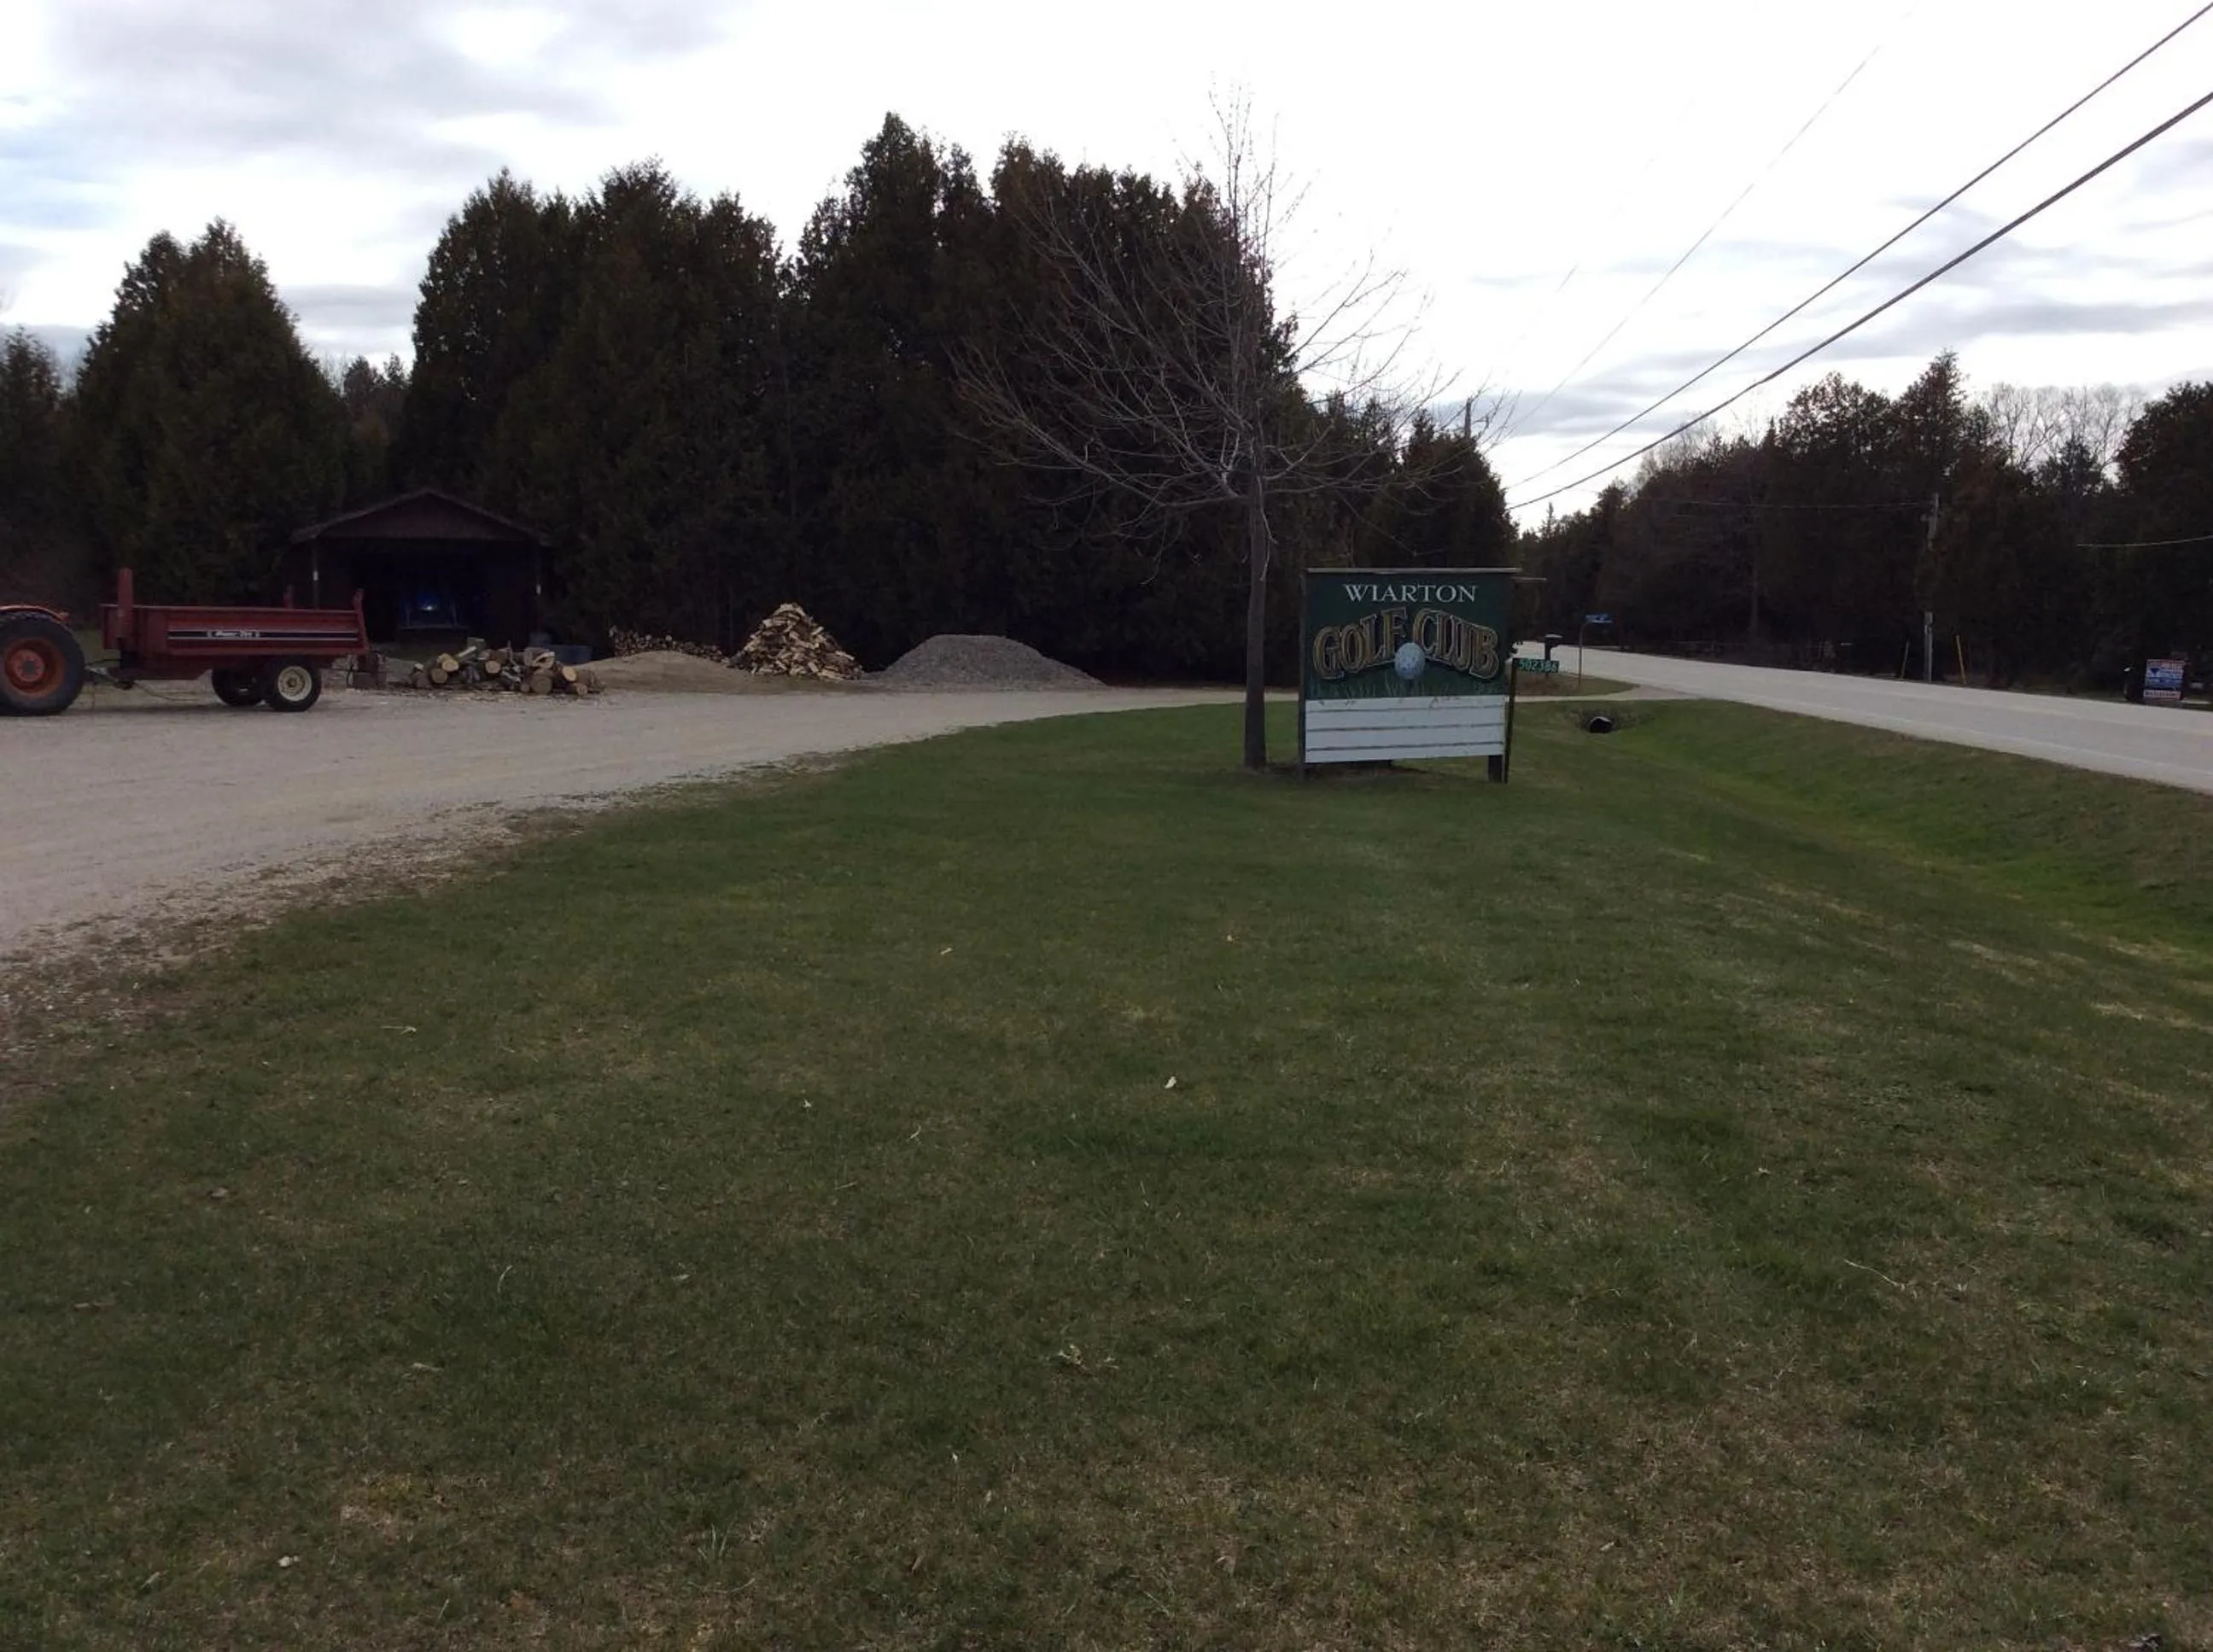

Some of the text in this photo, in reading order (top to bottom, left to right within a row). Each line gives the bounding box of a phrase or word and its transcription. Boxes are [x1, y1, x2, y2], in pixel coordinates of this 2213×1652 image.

[1343, 584, 1478, 603] WIARTON
[1313, 606, 1500, 680] GOLF CLUB
